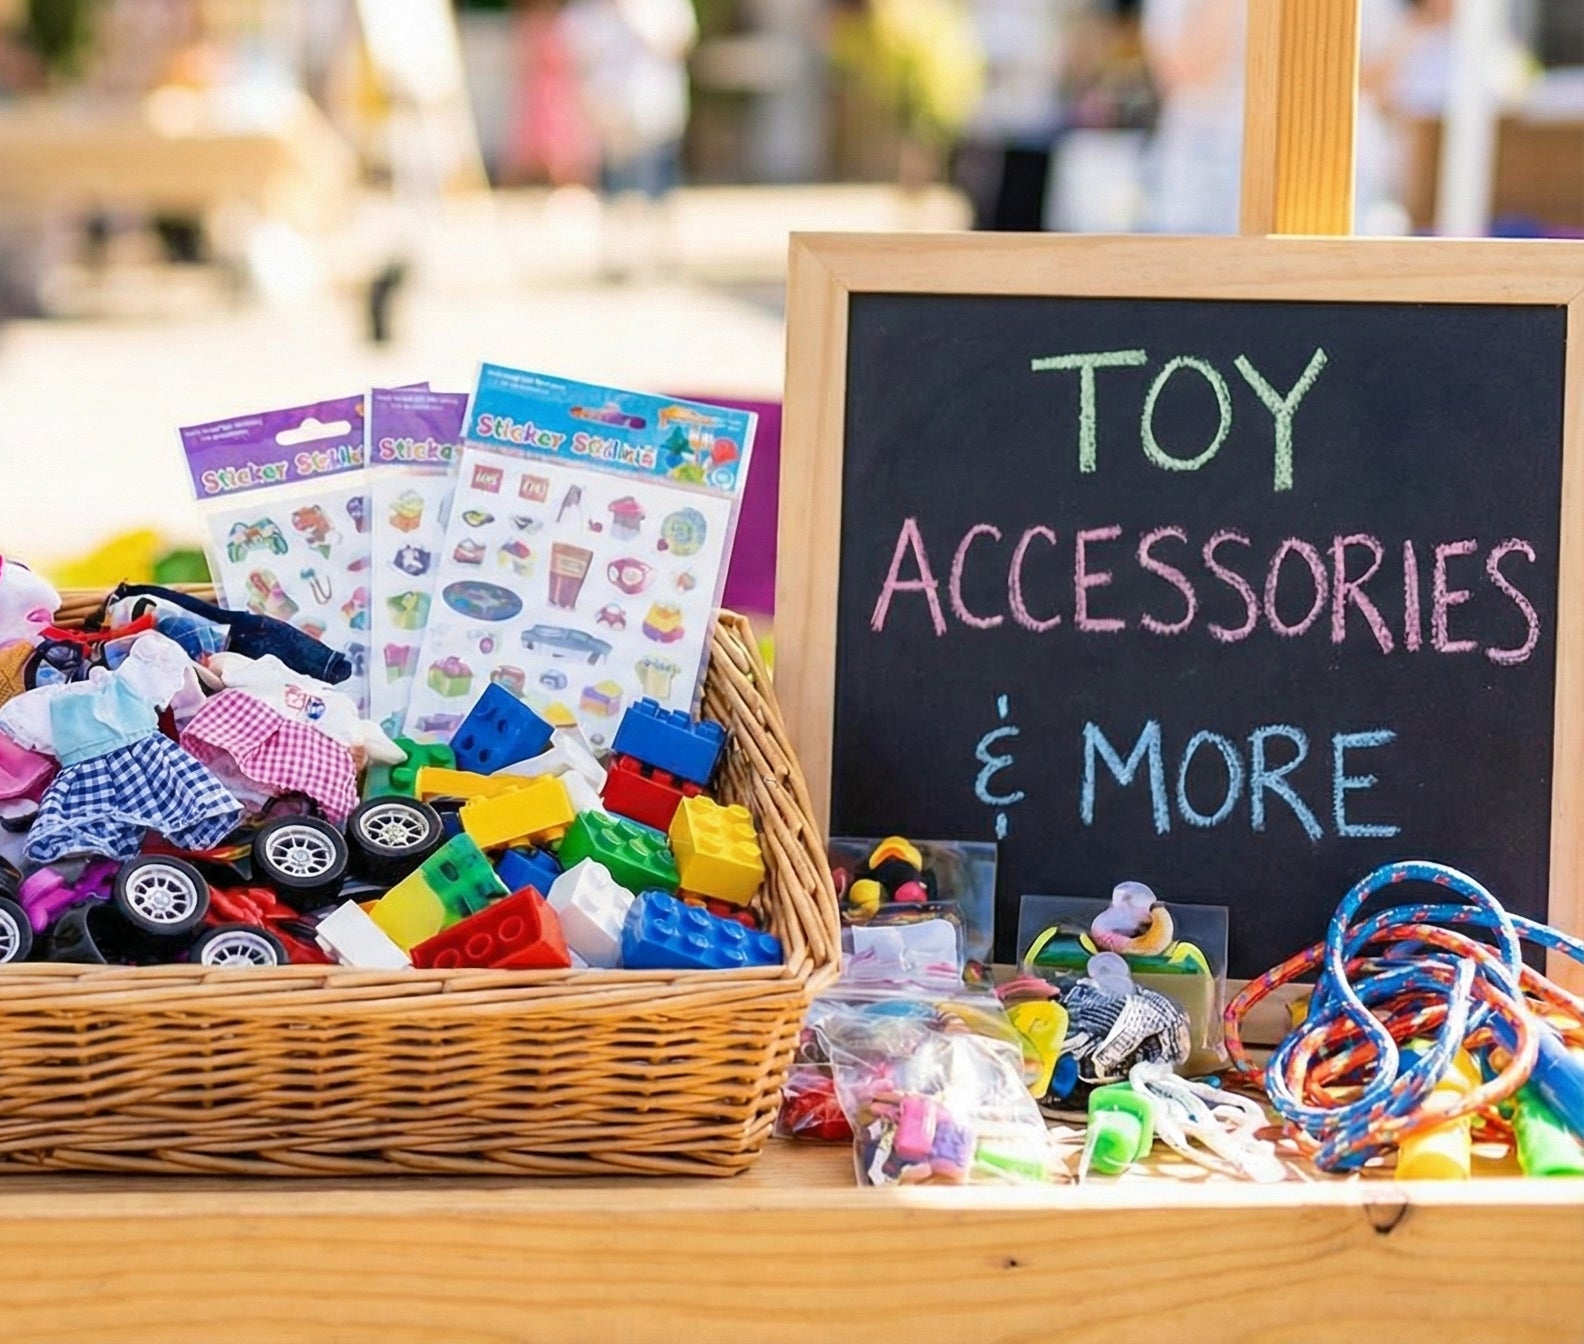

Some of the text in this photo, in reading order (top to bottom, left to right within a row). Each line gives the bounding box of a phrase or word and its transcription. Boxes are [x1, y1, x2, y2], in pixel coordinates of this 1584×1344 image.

[1030, 346, 1329, 492] TOY
[869, 516, 1542, 666] ACCESSORIES
[974, 693, 1402, 842] & MORE
